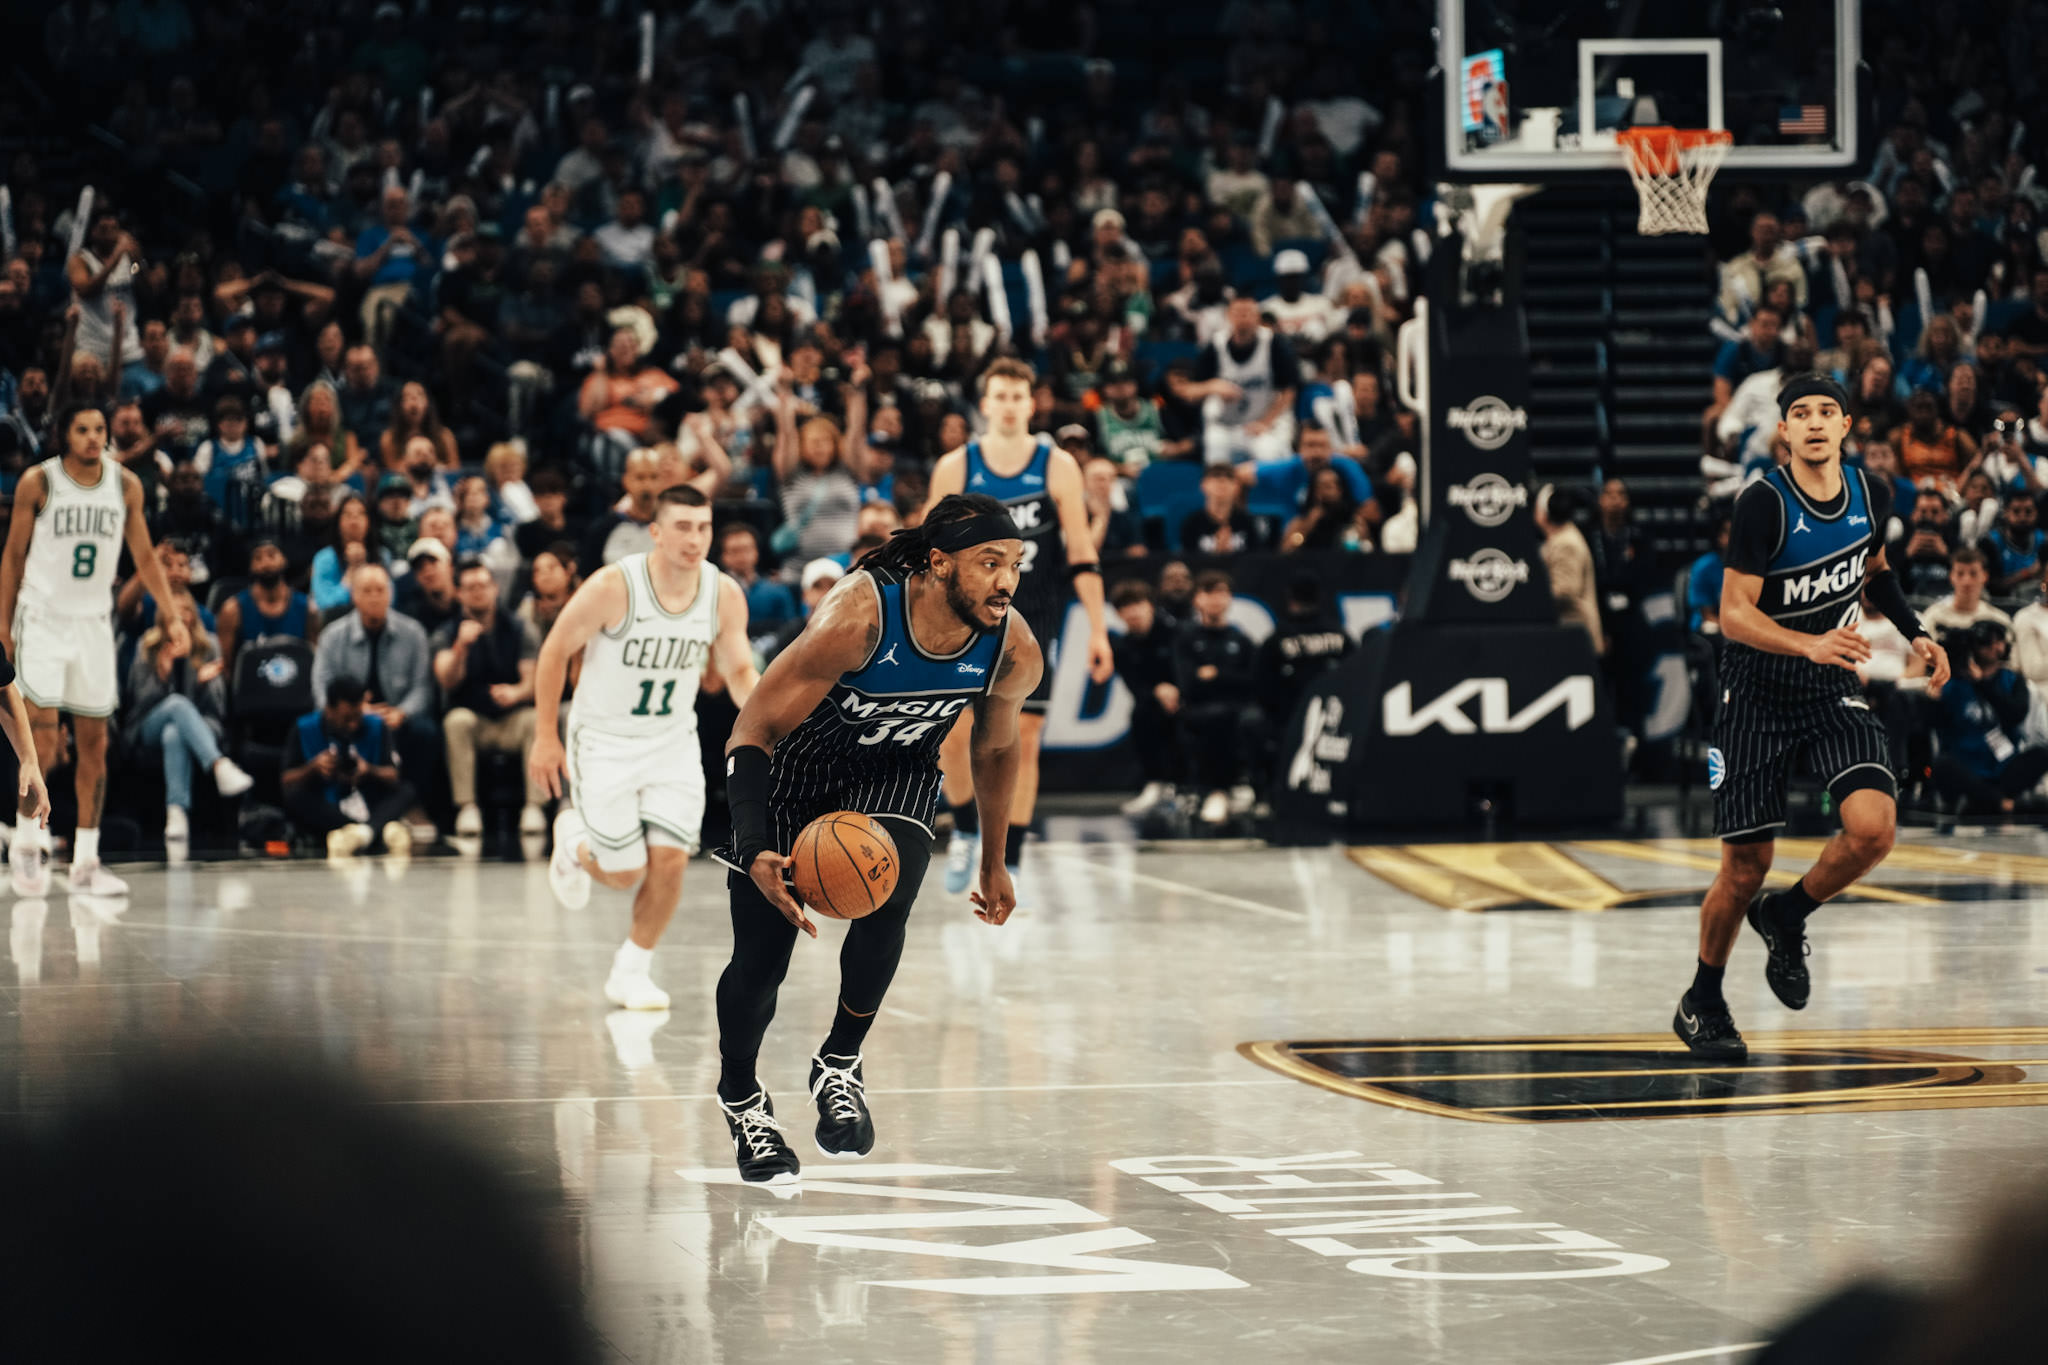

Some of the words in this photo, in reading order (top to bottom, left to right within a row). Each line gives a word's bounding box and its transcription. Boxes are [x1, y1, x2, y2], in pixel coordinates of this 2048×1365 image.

[72, 542, 97, 578] 8
[1783, 547, 1870, 606] MAGIC
[957, 662, 985, 676] Disney
[630, 678, 677, 716] 11
[841, 691, 969, 719] MAGIC
[1383, 674, 1595, 736] KIA
[857, 719, 938, 746] 34
[1108, 1150, 1671, 1281] CENTER
